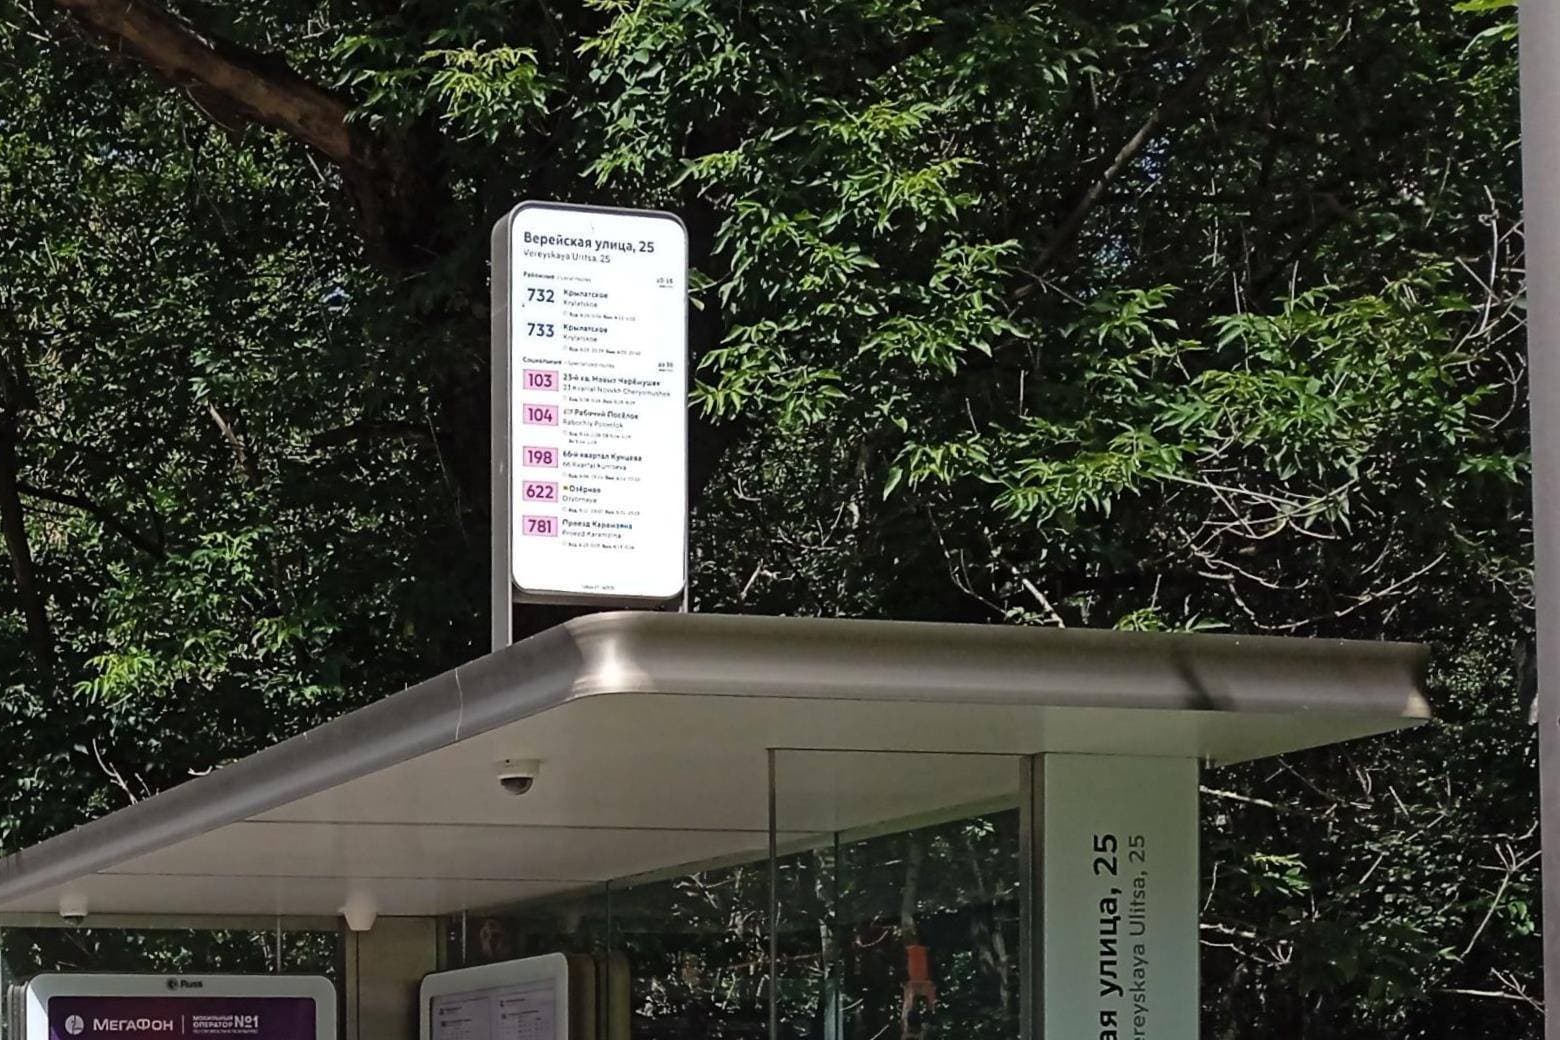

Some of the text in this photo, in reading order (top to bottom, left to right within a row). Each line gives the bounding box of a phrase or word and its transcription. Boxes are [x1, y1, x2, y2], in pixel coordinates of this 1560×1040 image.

[523, 231, 655, 254] Верейская улица, 25
[600, 255, 611, 263] 25
[526, 288, 555, 303] 732
[526, 323, 555, 338] 733
[528, 373, 552, 388] 103
[528, 408, 553, 422] 104
[527, 450, 553, 464] 198
[526, 485, 554, 499] 622
[528, 519, 553, 534] 781
[1093, 832, 1118, 876] 25
[1128, 835, 1145, 867] 25
[1128, 872, 1147, 937] Ulitsa,
[1099, 890, 1124, 998] улица,
